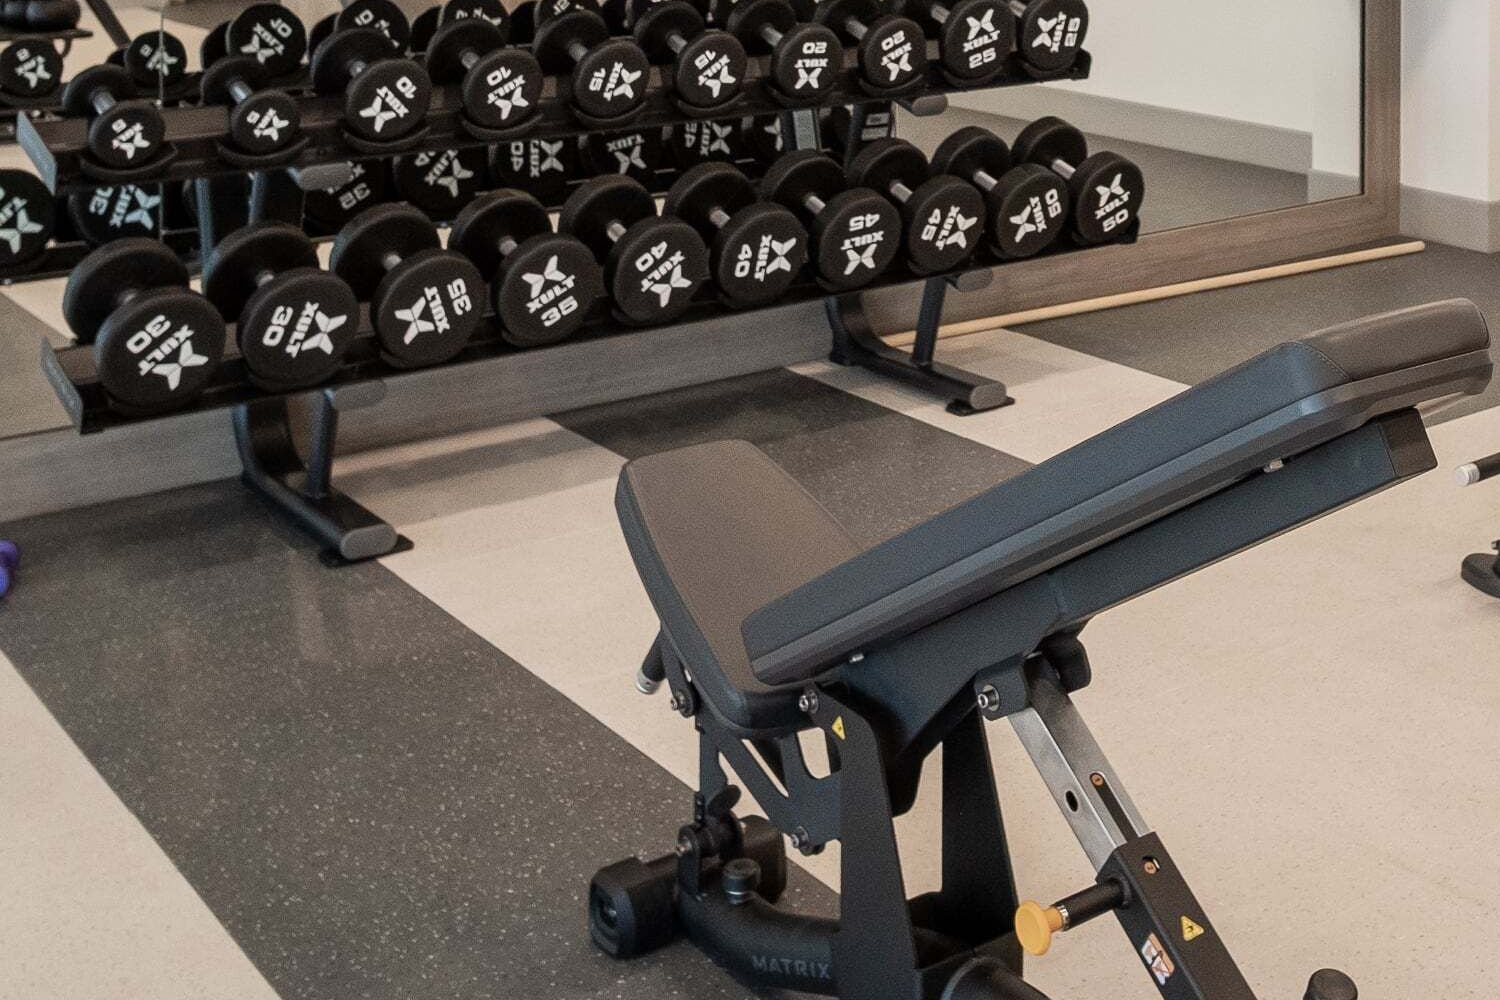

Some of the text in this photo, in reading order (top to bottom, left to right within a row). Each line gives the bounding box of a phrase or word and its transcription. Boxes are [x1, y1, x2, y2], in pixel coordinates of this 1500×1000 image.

[962, 29, 1001, 53] XULT
[969, 48, 997, 69] 25
[486, 66, 512, 87] 10
[1094, 190, 1131, 220] XULT
[1102, 209, 1129, 233] 50
[849, 213, 881, 232] 45
[635, 241, 668, 272] 40
[840, 230, 884, 250] XULT
[640, 250, 686, 293] XULT
[734, 243, 752, 278] 40
[754, 234, 772, 282] XULT
[424, 286, 450, 334] XULT
[447, 278, 473, 316] 35
[526, 274, 576, 314] XULT
[262, 305, 294, 347] 30
[540, 295, 579, 327] 35
[126, 314, 172, 354] 30
[285, 301, 320, 359] XULT
[136, 324, 195, 377] XULT
[751, 954, 831, 980] MATRIX
